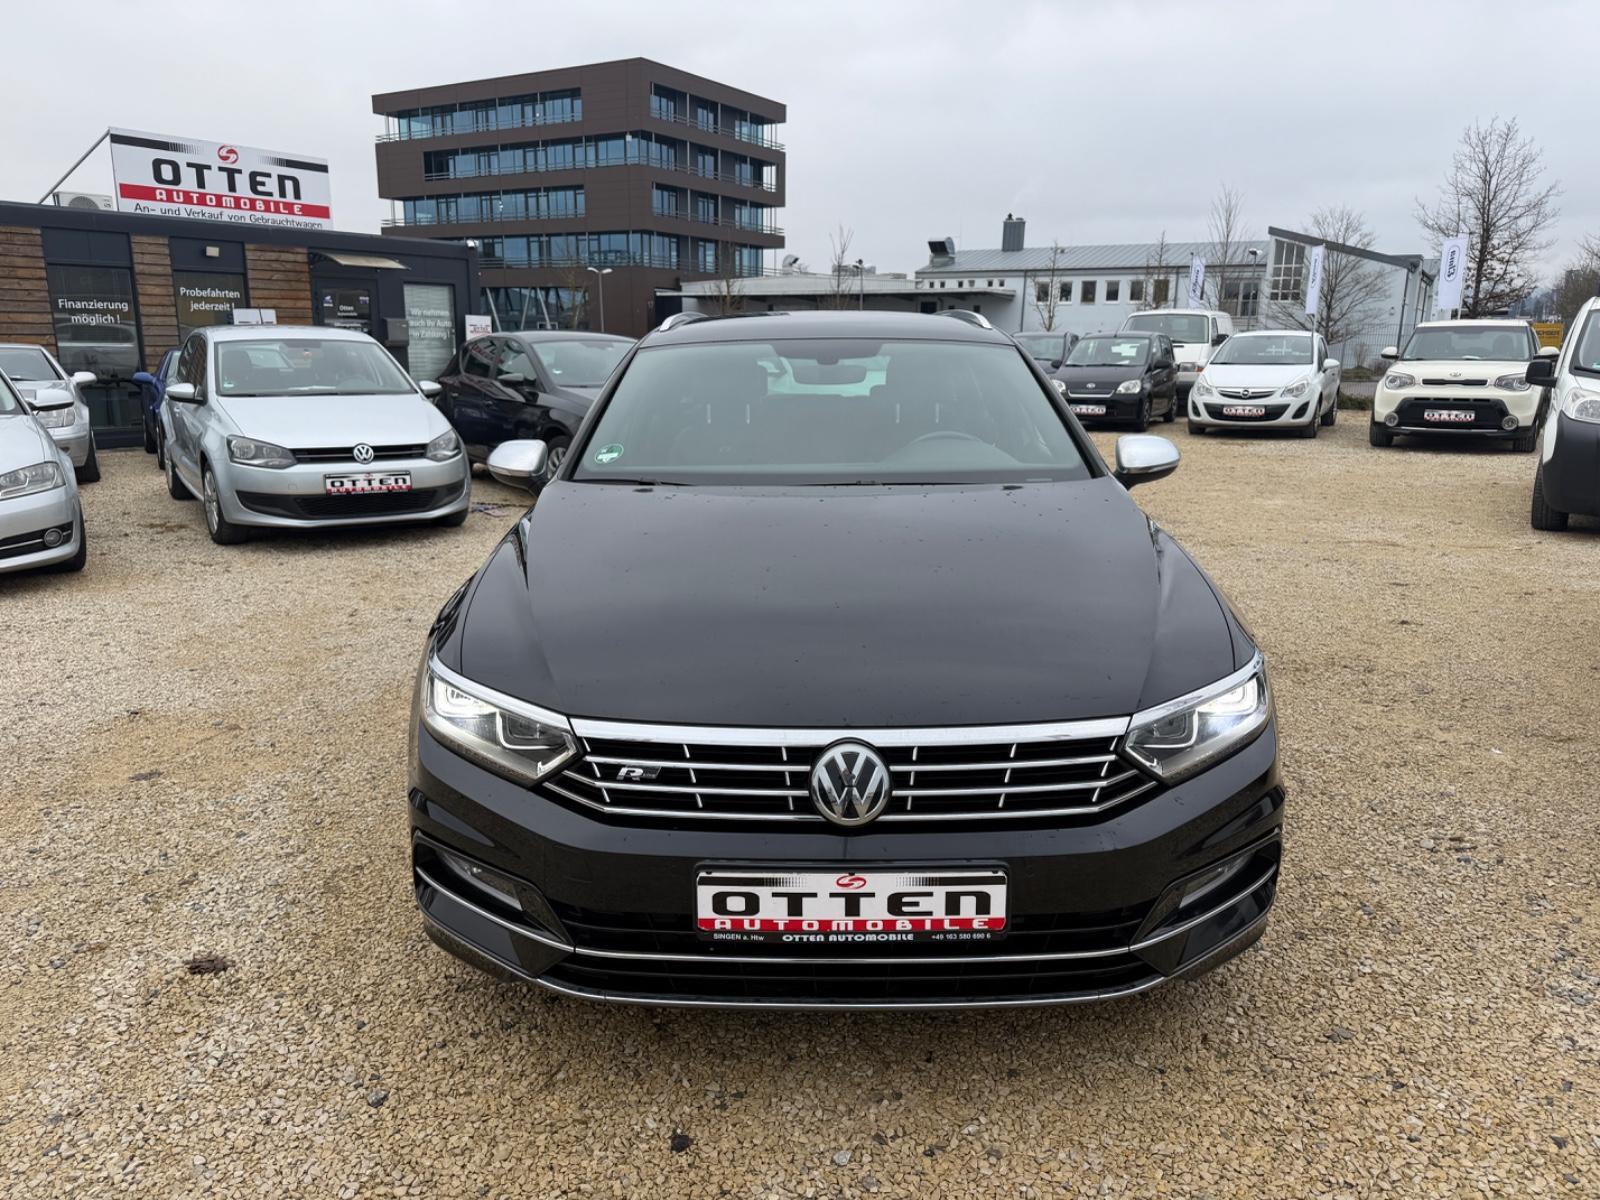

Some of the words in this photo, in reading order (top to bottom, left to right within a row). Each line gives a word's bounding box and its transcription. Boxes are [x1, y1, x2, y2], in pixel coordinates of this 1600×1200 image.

[152, 158, 302, 200] OTTEN
[155, 189, 304, 215] AUTOMOBILE
[134, 203, 156, 213] An-
[161, 205, 181, 216] und
[184, 207, 224, 220] Verkauf
[227, 213, 246, 222] von
[249, 214, 323, 230] Gebrauchtwagen
[180, 287, 240, 299] Probefahrten
[58, 299, 128, 312] Finanzierung
[190, 300, 230, 311] jederzeit
[71, 313, 115, 326] möglich
[330, 477, 407, 488] OTTEN
[711, 891, 991, 917] OTTEN
[714, 918, 989, 931] AUTOMOBILE
[782, 934, 825, 942] OTTEN
[828, 933, 914, 941] AUTOMOBILE
